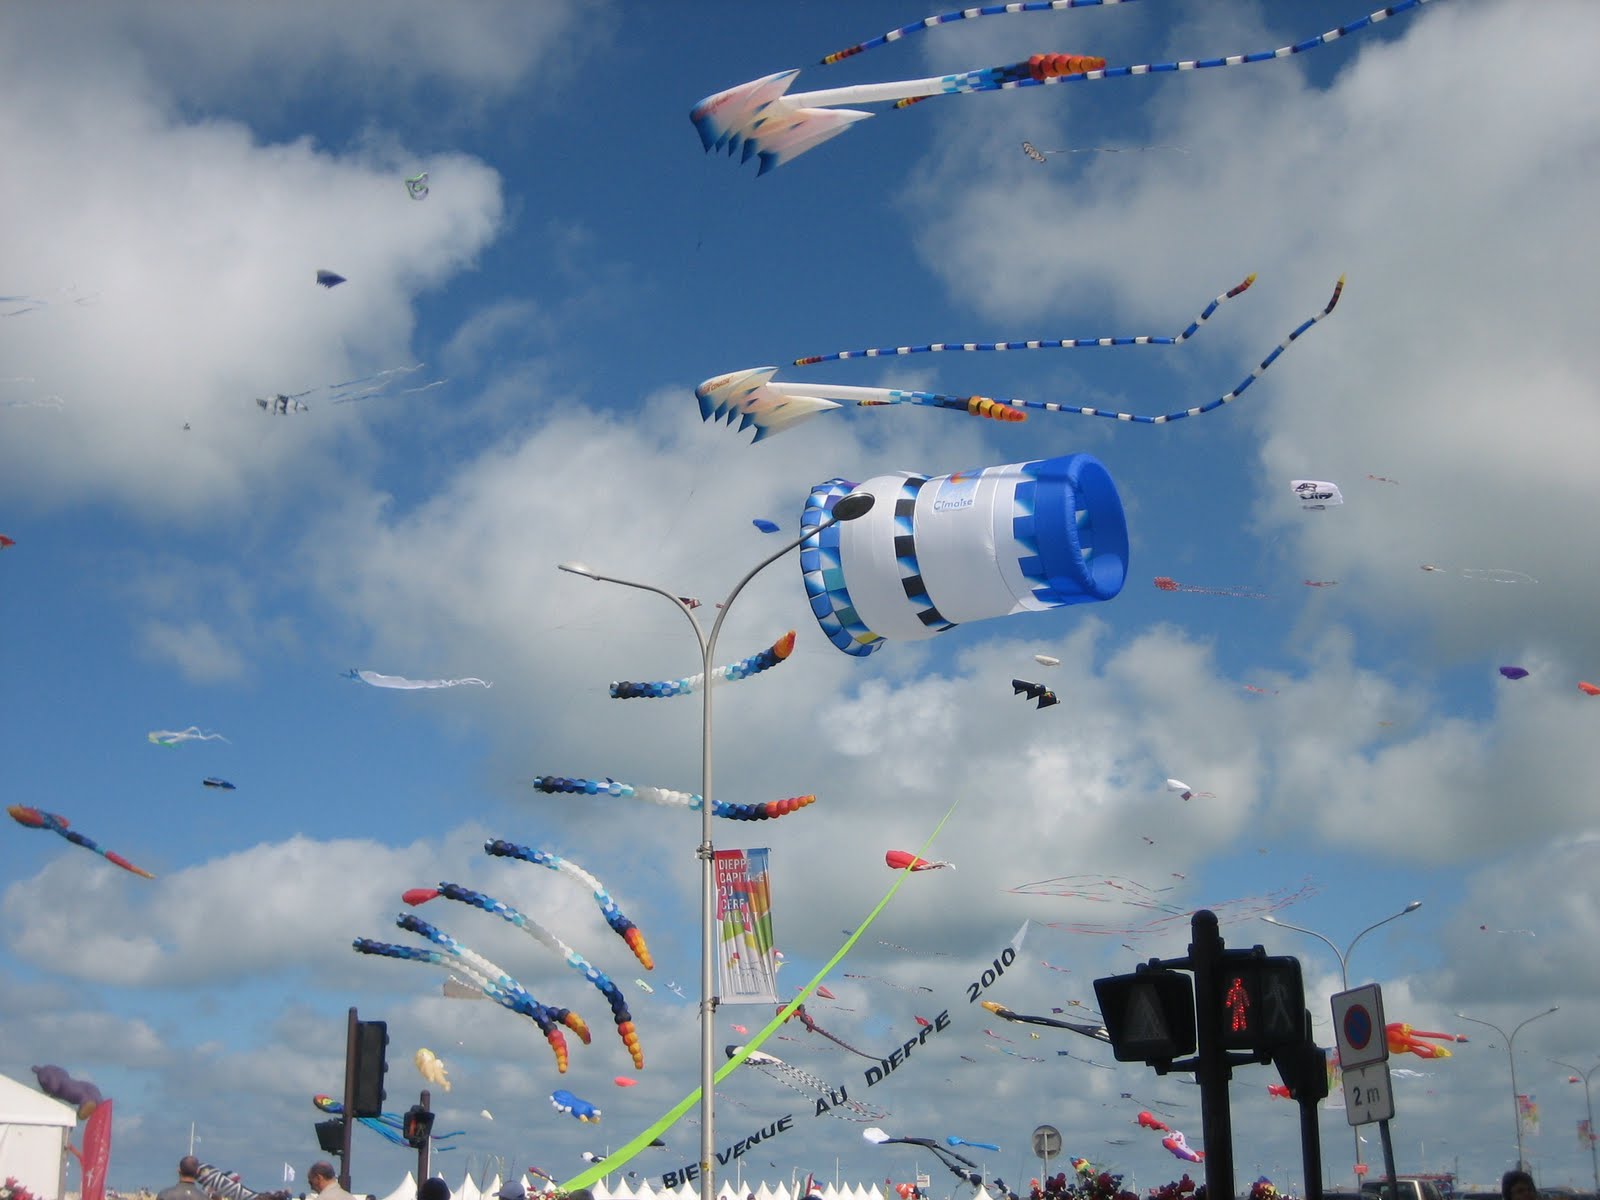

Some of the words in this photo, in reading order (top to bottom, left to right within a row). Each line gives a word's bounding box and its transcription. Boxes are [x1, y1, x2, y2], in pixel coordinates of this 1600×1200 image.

[718, 858, 752, 870] DIEPPE
[720, 885, 733, 897] DU
[722, 898, 745, 910] CERF
[662, 1113, 794, 1189] BIEVENUE
[814, 1085, 848, 1117] AU
[864, 1010, 951, 1087] DIEPPE
[966, 947, 1016, 1003] 2010
[1352, 1086, 1362, 1107] 2
[1366, 1086, 1380, 1104] m
